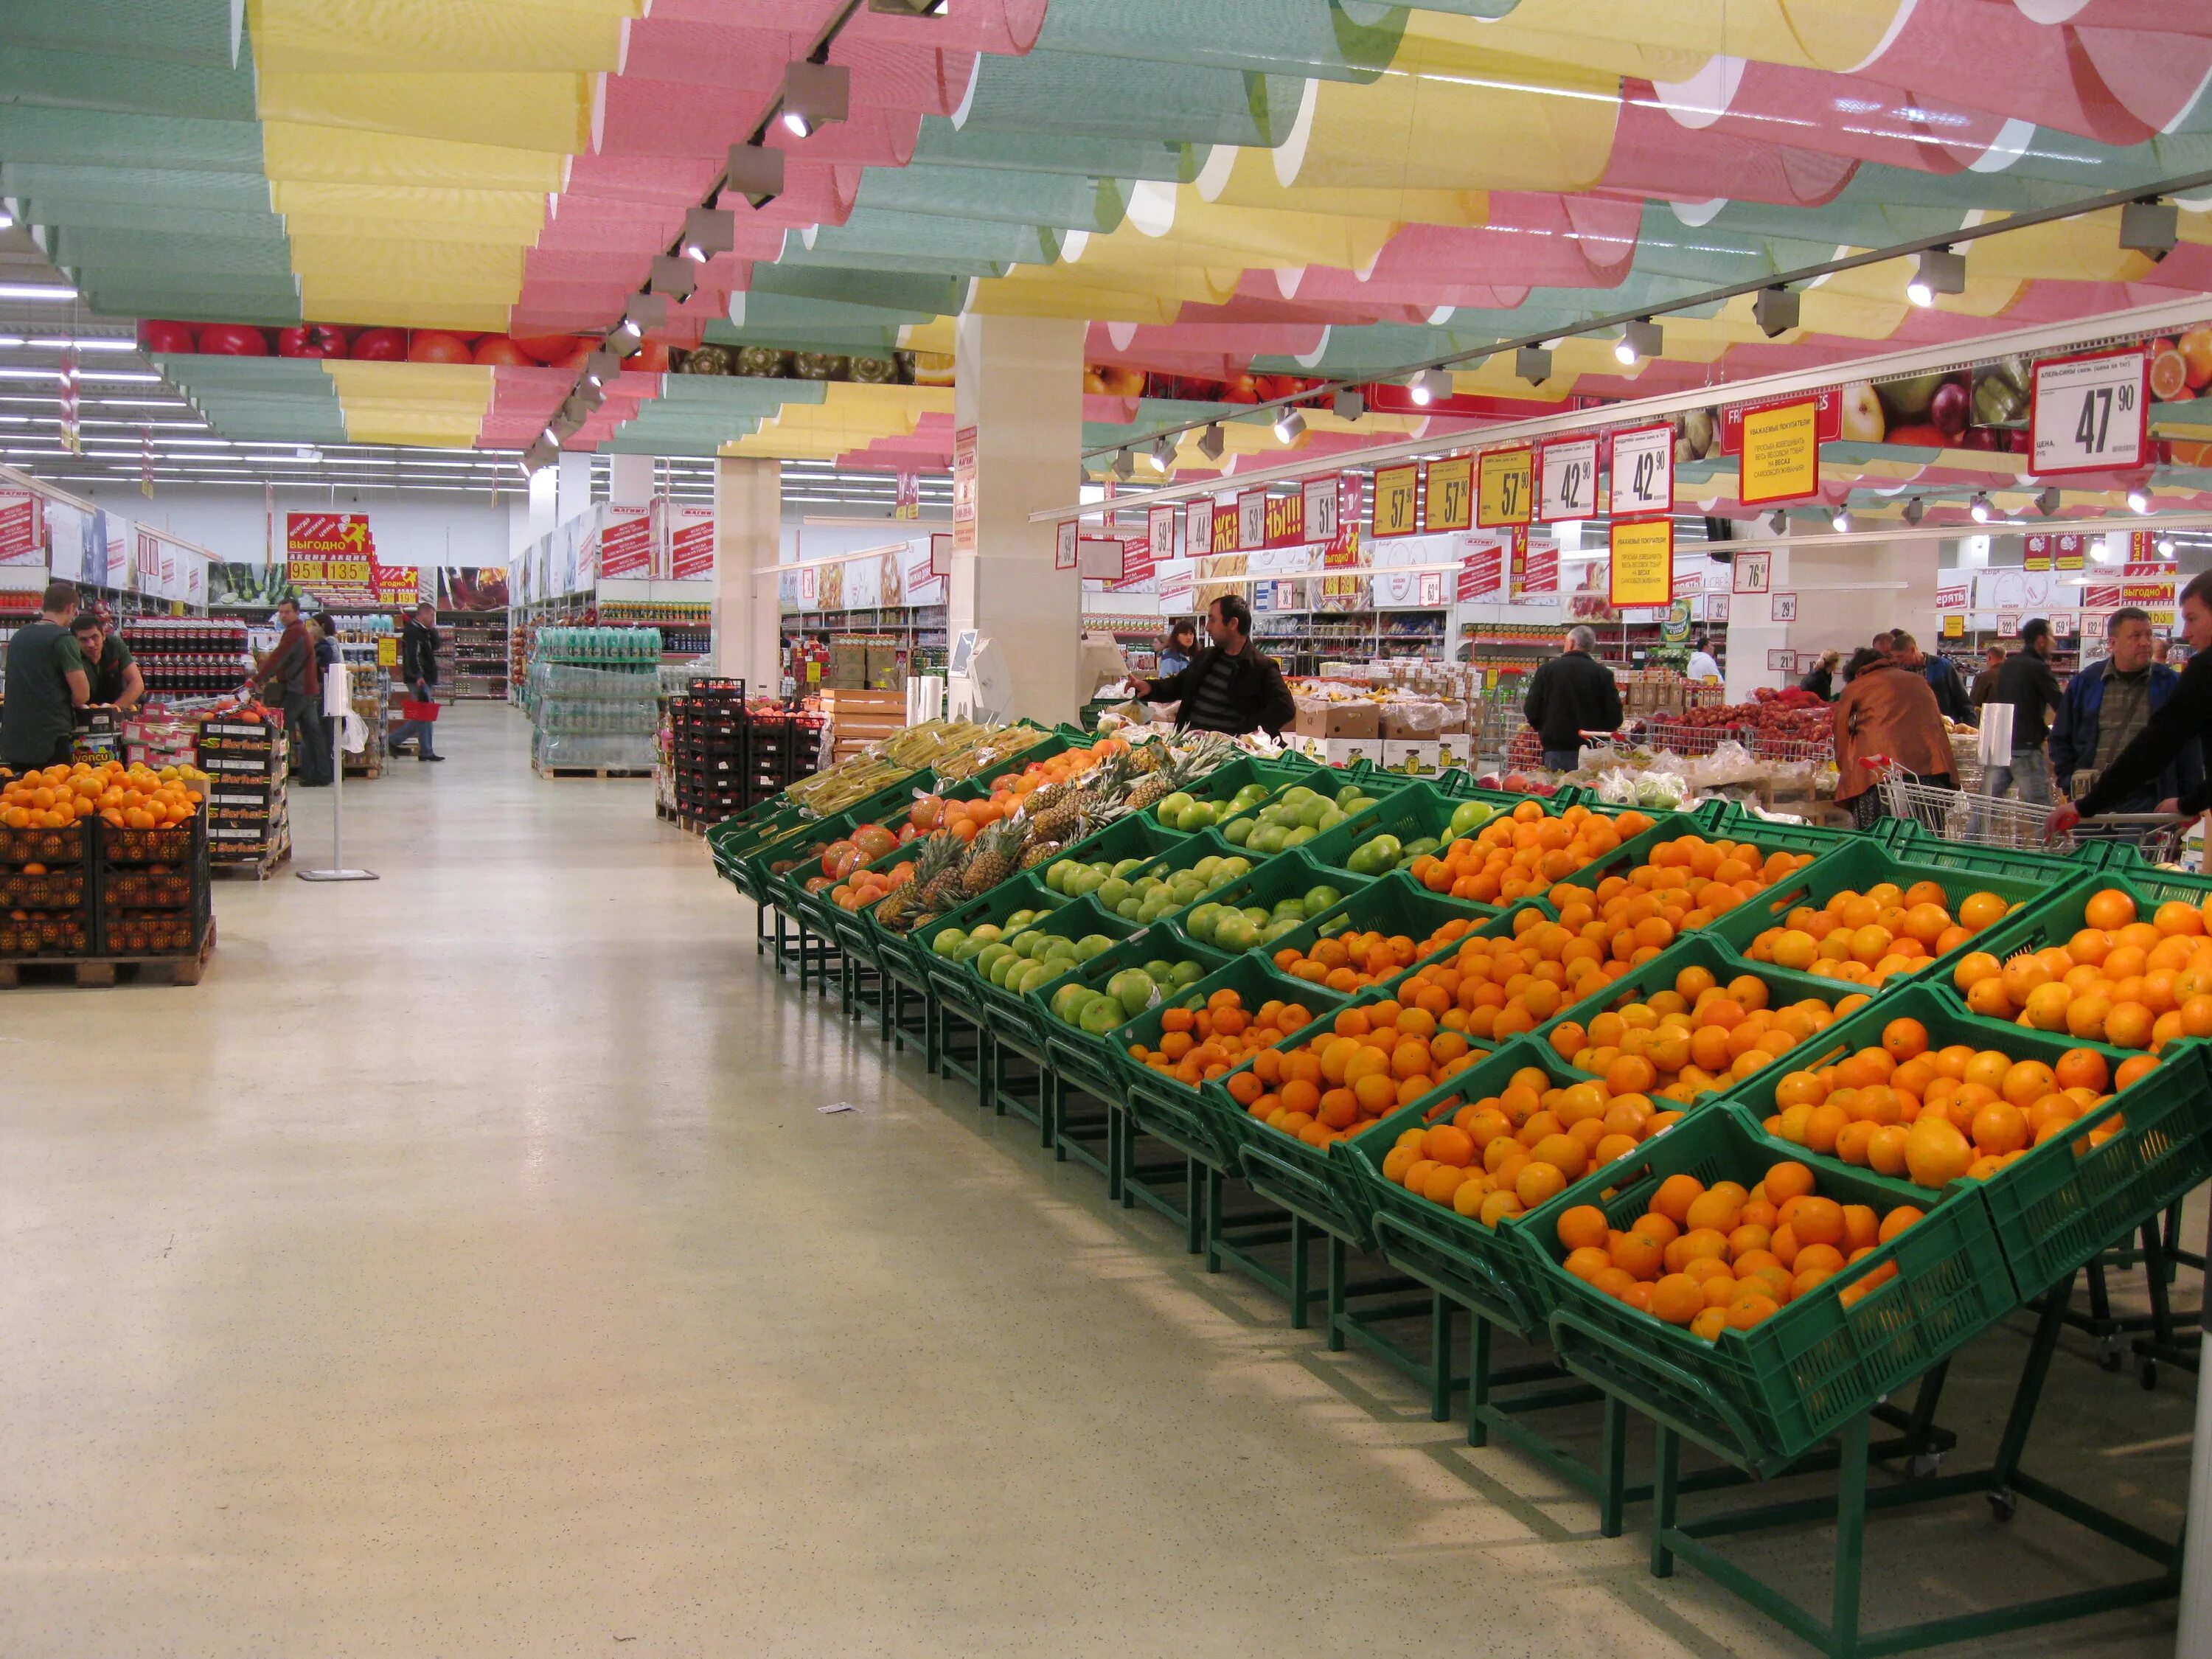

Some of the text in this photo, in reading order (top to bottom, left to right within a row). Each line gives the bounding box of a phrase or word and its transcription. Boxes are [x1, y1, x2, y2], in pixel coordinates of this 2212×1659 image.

[2076, 384, 2134, 453] 47 90
[1750, 425, 1779, 436] УВАЖАЕМЫЕ
[2037, 440, 2055, 448] ЦЕНА,
[1775, 458, 1791, 466] ВЕСАХ
[1633, 451, 1665, 501] 42 90
[1502, 471, 1528, 515] 57 90
[1561, 461, 1590, 509] 42 90
[1391, 489, 1405, 528] 57
[1444, 480, 1468, 523] 57 90
[1319, 498, 1330, 535] 51
[1196, 516, 1206, 548] 44
[1249, 508, 1258, 542] 53
[1158, 522, 1167, 552] 59
[289, 540, 346, 551] ВЫГОДНО
[1325, 553, 1349, 563] ВЫГОДНО
[292, 563, 310, 578] 95
[331, 564, 357, 579] 135
[1748, 564, 1759, 588] 76
[1427, 584, 1435, 601] 63
[2124, 588, 2160, 599] ВЫГОДНО
[1717, 603, 1723, 618] 32
[1782, 602, 1790, 617] 29
[2002, 622, 2012, 634] 322
[2056, 622, 2065, 633] 159
[2087, 622, 2097, 634] 132
[1781, 656, 1788, 668] 21
